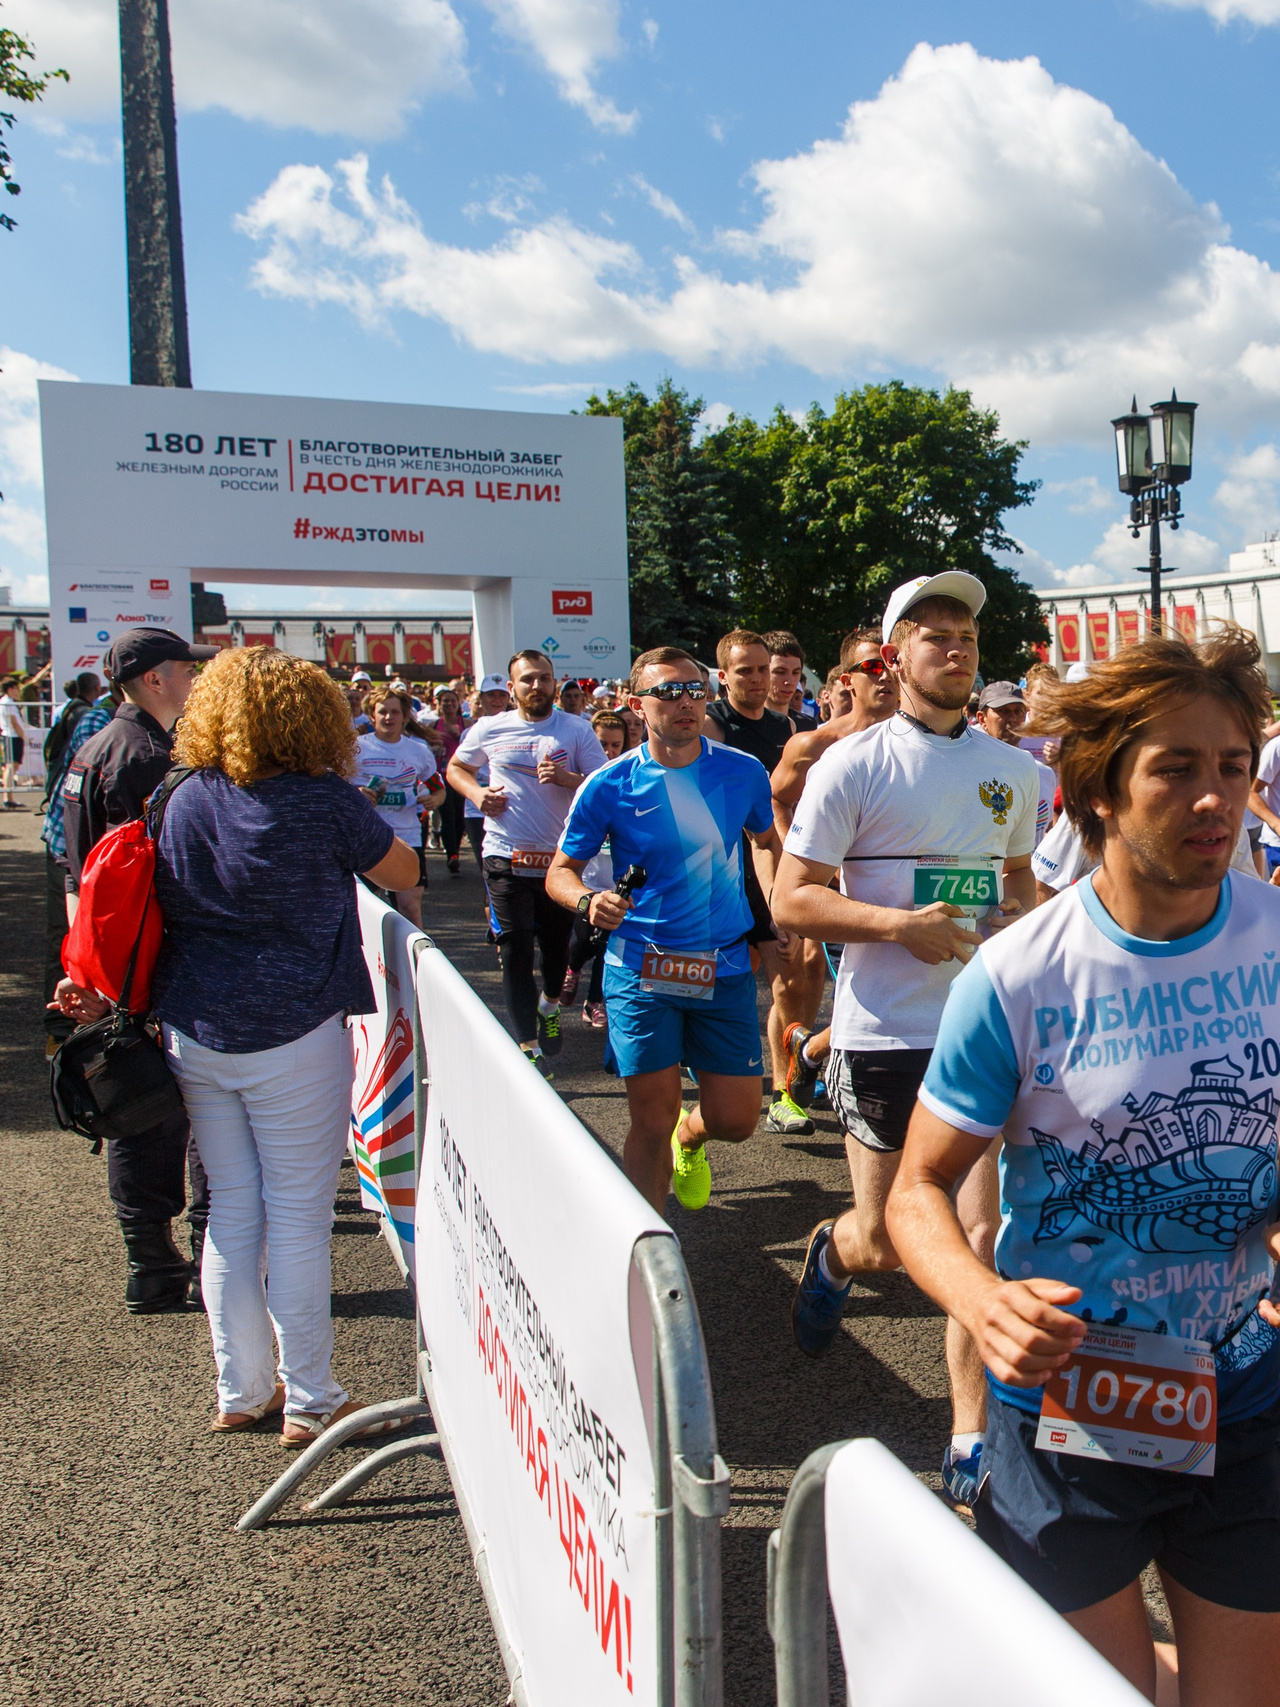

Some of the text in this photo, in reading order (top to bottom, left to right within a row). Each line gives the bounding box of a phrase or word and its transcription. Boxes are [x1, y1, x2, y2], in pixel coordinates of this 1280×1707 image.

[145, 432, 277, 457] 180 ЛЕТ
[300, 439, 562, 465] БЛАГОТВОРИТЕЛЬНЫЙ ЗАБЕГ
[116, 461, 279, 478] ЖЕЛЕЗНЫМ ДОРОГАМ
[300, 453, 564, 478] В ЧЕСТЬ ДНЯ ЖЕЛЕЗНОДОРОЖНИКА
[220, 479, 279, 492] РОССИИ
[303, 471, 561, 503] ДОСТИГАЯ ЦЕЛИ!
[515, 853, 552, 867] 1070
[930, 875, 991, 900] 7745
[648, 957, 713, 983] 10160
[1069, 1011, 1264, 1073] ПОЛУМАРАФОН
[452, 1138, 467, 1223] ЛЕТ
[474, 1183, 627, 1498] БЛАГОТВОРИТЕЛЬНЫЙ ЗАБЕГ
[1108, 1339, 1137, 1351] ЦЕЛИ!
[1195, 1357, 1205, 1369] 10
[1059, 1364, 1212, 1431] 10780
[478, 1283, 634, 1695] ДОСТИГАЯ ЦЕЛИ!
